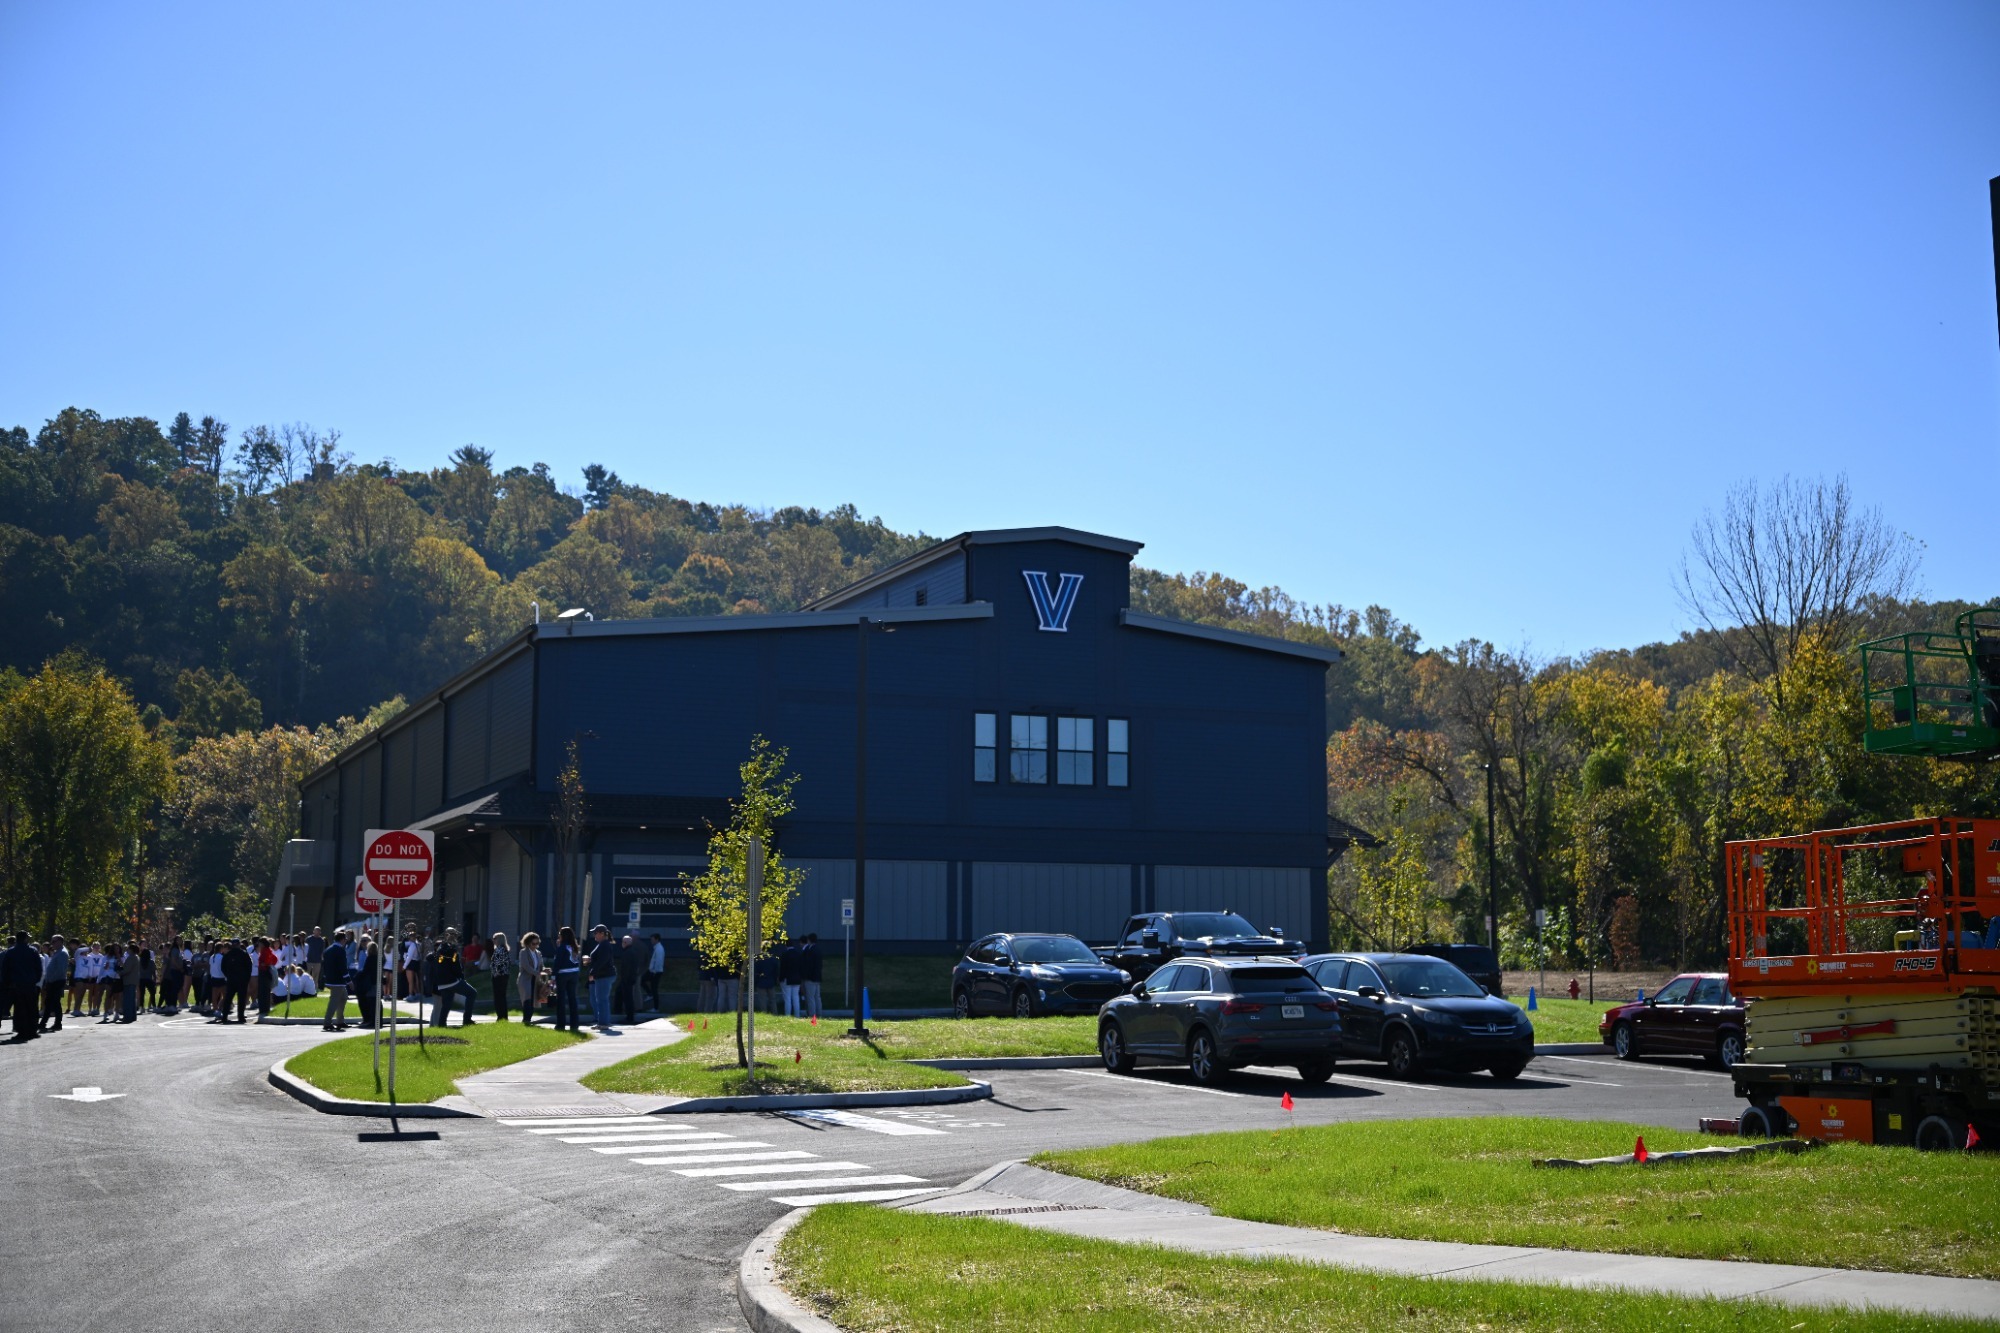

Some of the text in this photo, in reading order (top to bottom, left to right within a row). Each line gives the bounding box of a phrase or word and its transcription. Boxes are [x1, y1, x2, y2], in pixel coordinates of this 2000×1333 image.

[1023, 570, 1084, 632] V
[376, 844, 423, 855] DO NOT
[379, 874, 417, 885] ENTER
[620, 887, 671, 895] CAVANAUGH
[637, 897, 686, 906] BOATHOUSE
[1893, 957, 1938, 971] R4045
